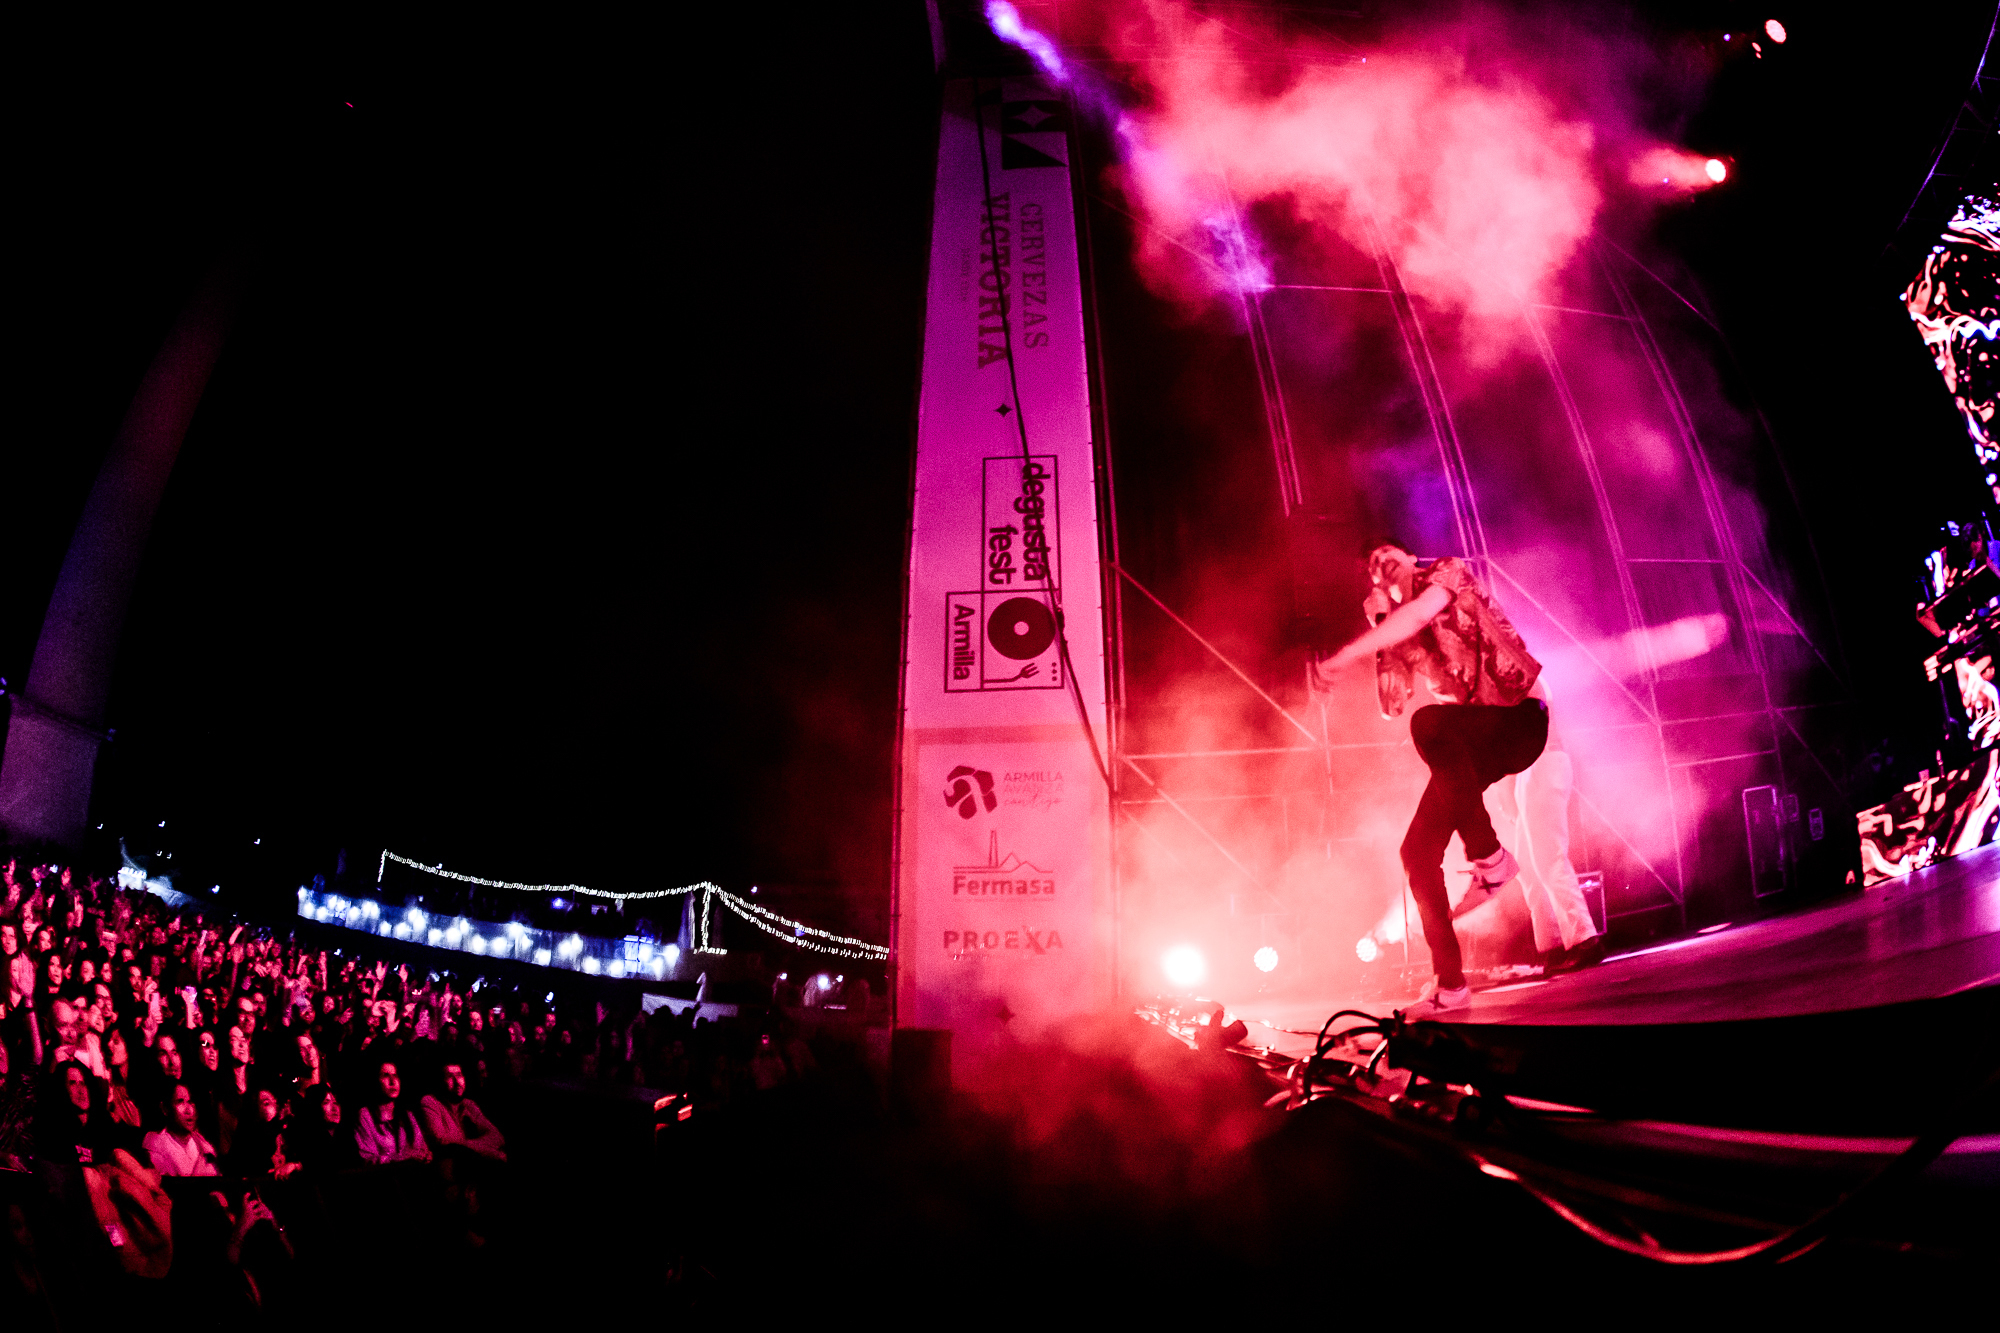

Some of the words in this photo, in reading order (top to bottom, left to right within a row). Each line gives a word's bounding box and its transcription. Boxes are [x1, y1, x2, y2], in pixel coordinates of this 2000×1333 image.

[977, 192, 1011, 370] VICTORIA
[1020, 203, 1048, 349] CERVEZAS
[988, 525, 1018, 585] fest
[1014, 462, 1051, 581] degusta
[953, 604, 975, 680] Armilla
[1003, 771, 1064, 783] ARMILLA
[953, 876, 1055, 895] Fermasa
[943, 928, 1064, 955] PROEXA
